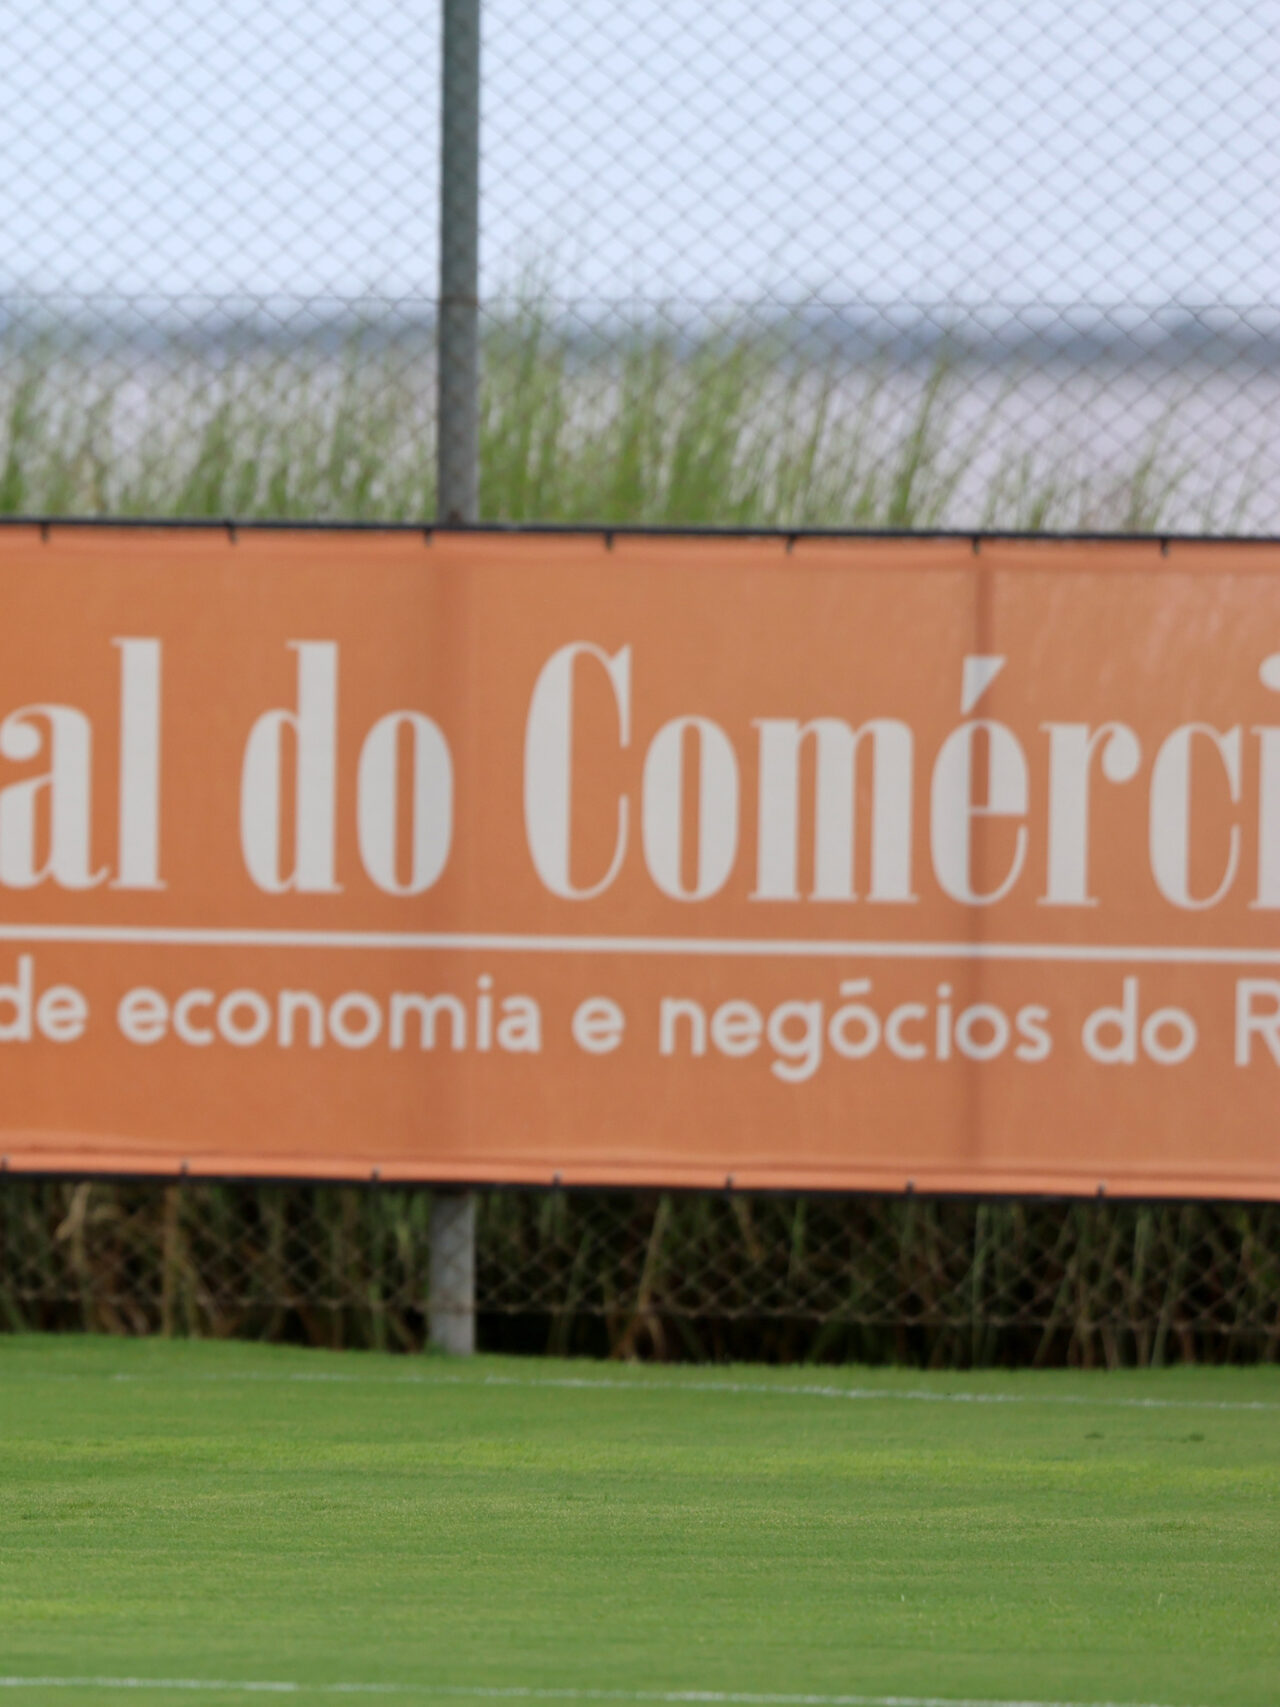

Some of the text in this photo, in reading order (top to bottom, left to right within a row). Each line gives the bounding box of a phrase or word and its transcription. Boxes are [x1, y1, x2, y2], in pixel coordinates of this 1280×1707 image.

[240, 640, 454, 897] do
[524, 641, 1280, 910] Comérci
[117, 974, 542, 1053] economia
[572, 996, 625, 1054] e
[659, 978, 1052, 1083] negócios
[1081, 976, 1198, 1065] do
